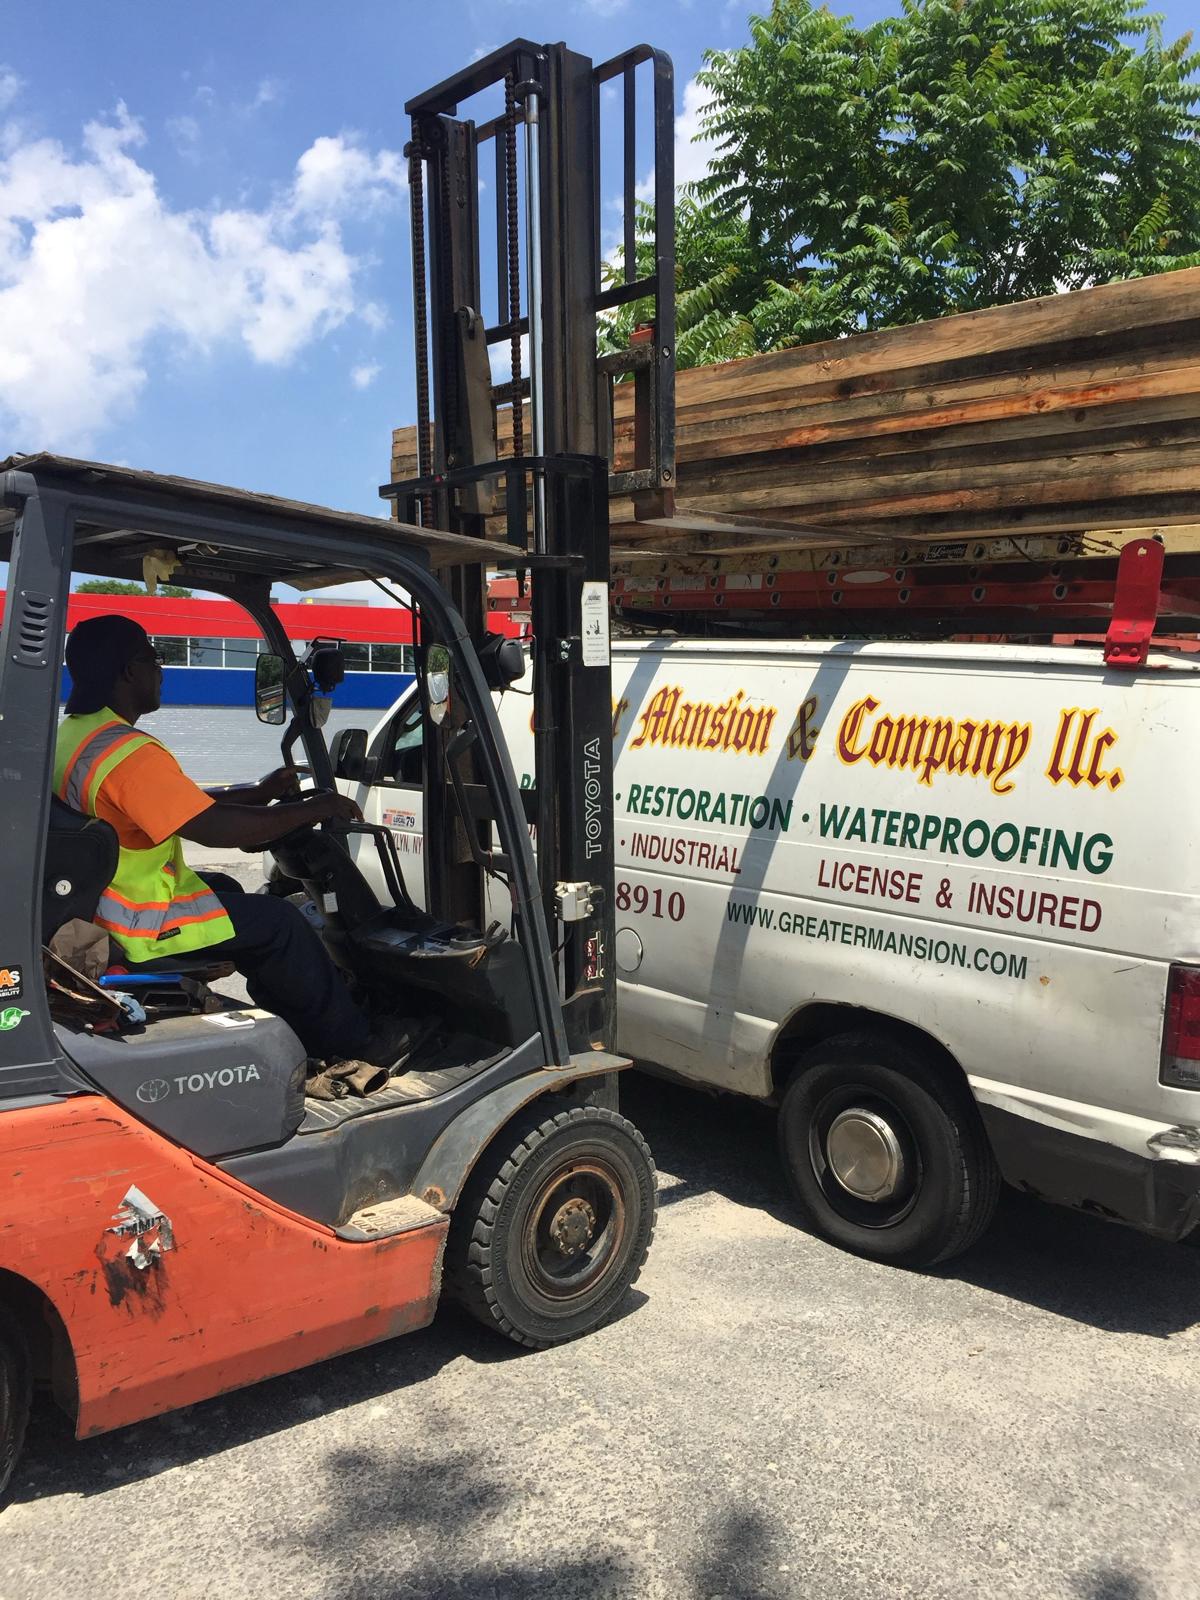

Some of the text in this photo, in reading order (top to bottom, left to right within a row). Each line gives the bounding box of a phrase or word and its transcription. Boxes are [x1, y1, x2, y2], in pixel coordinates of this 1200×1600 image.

[629, 684, 777, 756] Mansion
[787, 695, 820, 761] &
[837, 695, 1032, 794] Company
[406, 816, 415, 828] 79
[584, 737, 602, 859] TOYOTA
[626, 784, 1114, 875] RESTORATION WATERPROOFING
[630, 832, 742, 874] INDUSTRIAL
[615, 882, 685, 922] 8910
[817, 859, 1103, 933] LICENSE & INSURED
[727, 901, 1028, 979] WWW.GREATERMANSION.COM
[174, 1063, 261, 1095] TOYOTA
